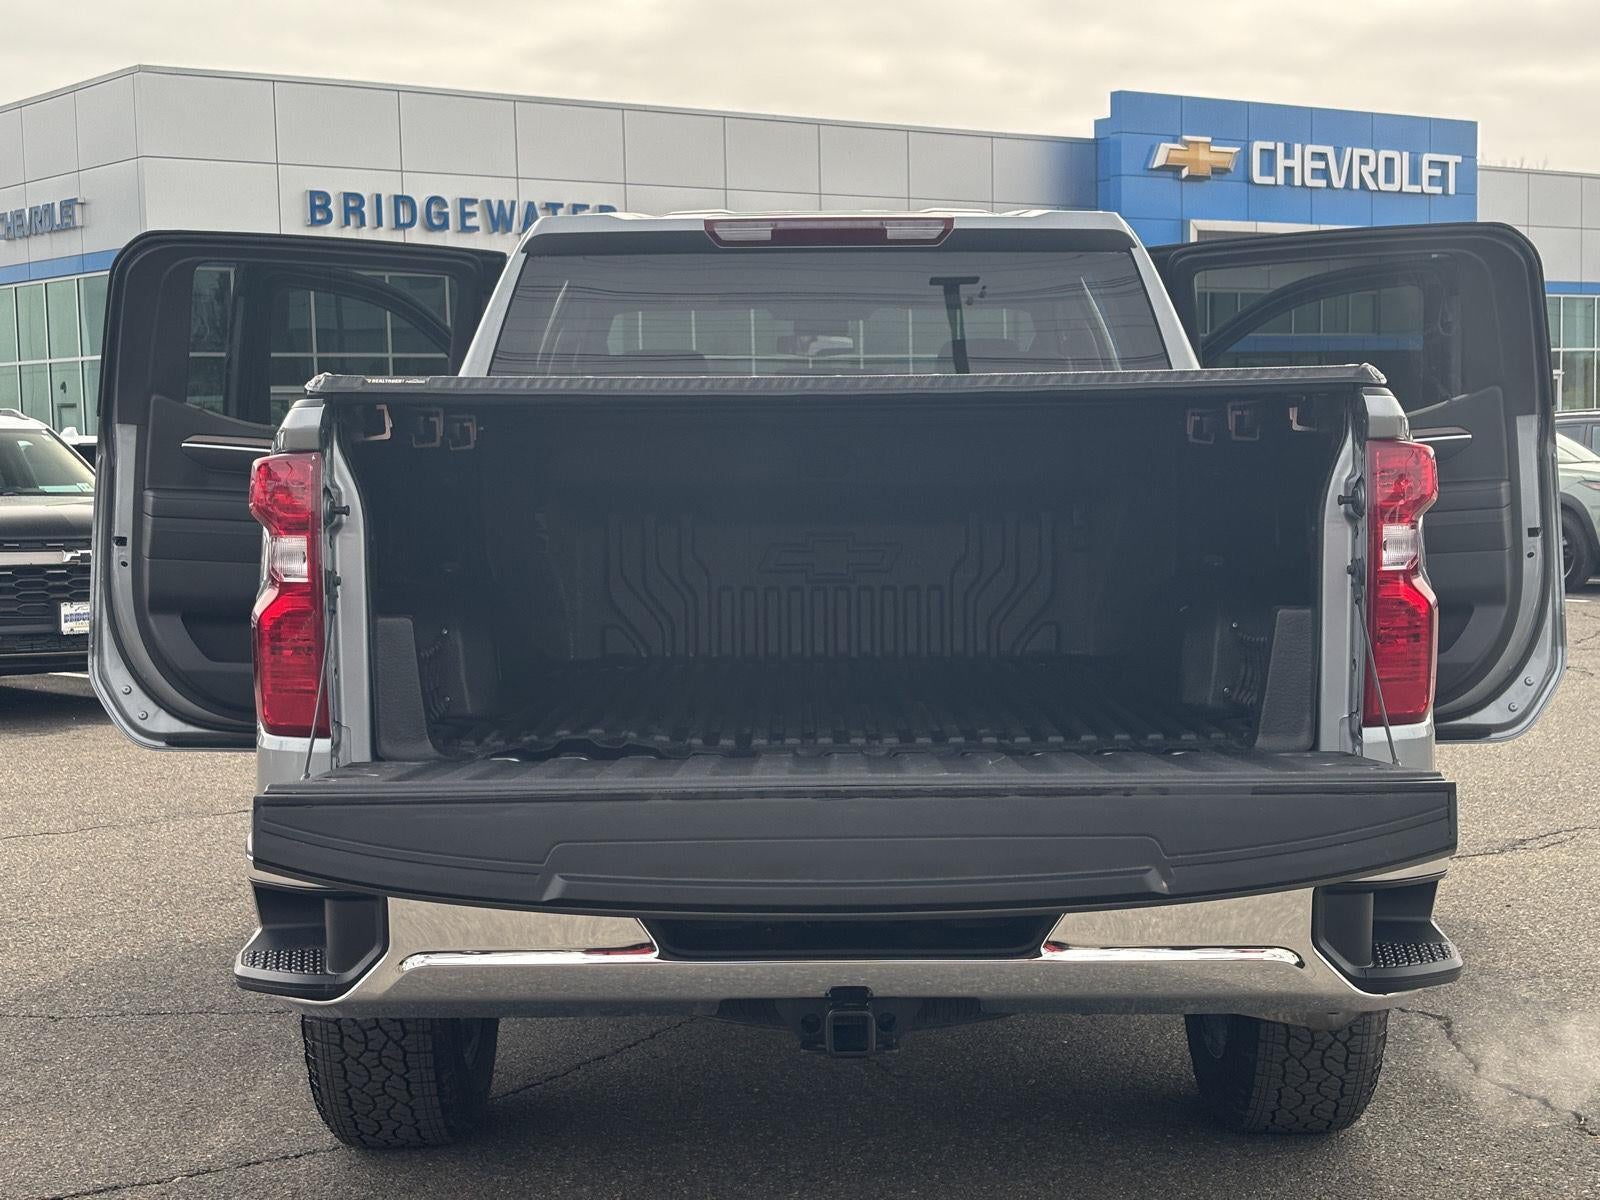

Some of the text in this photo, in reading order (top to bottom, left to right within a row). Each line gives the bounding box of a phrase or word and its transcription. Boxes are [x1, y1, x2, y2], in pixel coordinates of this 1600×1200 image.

[1252, 141, 1462, 195] CHEVROLET
[307, 189, 617, 234] BRIDGEWA
[64, 612, 90, 623] BRIDG
